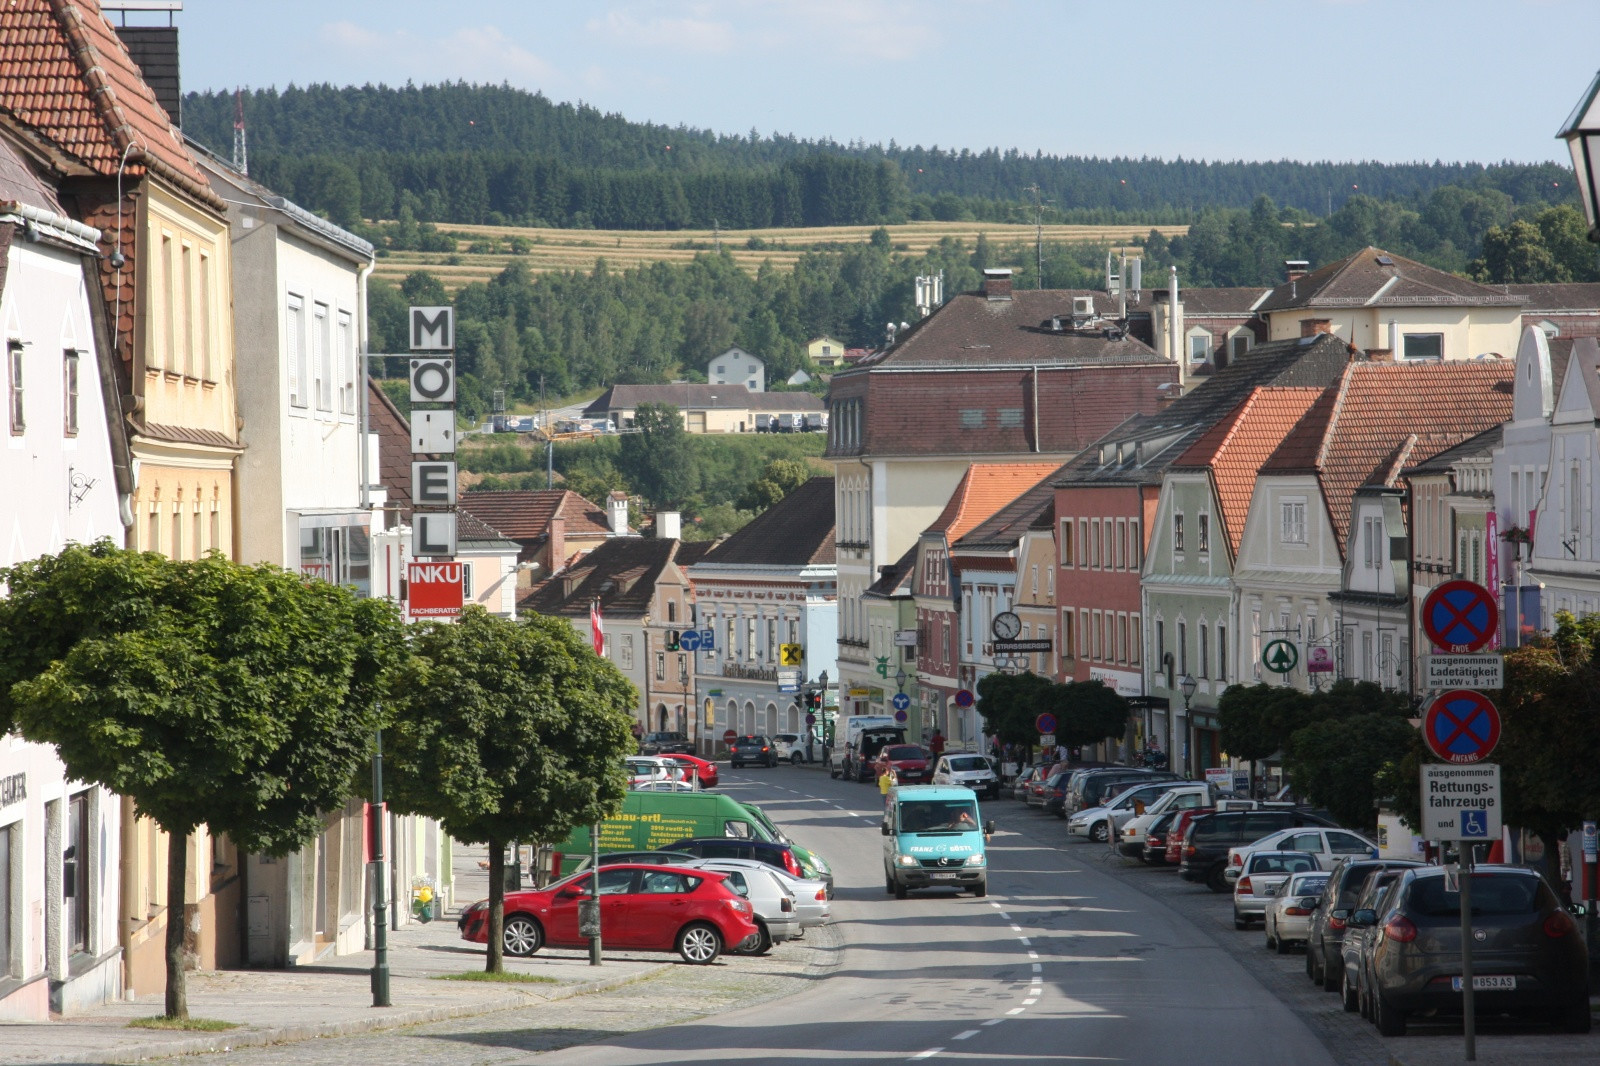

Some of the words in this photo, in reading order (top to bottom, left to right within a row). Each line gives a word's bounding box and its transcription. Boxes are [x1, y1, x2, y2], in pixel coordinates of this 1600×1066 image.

[410, 565, 460, 584] INKU
[702, 630, 712, 644] P
[995, 642, 1050, 650] STRASSBERGER
[1451, 645, 1470, 653] ENDE
[1430, 658, 1498, 667] ausgenommen
[1430, 667, 1498, 678] Ladetätigkeit
[1451, 753, 1479, 762] ANFANG
[1428, 769, 1494, 779] ausgenommen
[1430, 781, 1494, 795] Rettungs-
[1429, 795, 1495, 809] fahrzeuge
[1438, 819, 1454, 827] und
[1480, 977, 1498, 987] 853
[1500, 977, 1513, 987] AS
